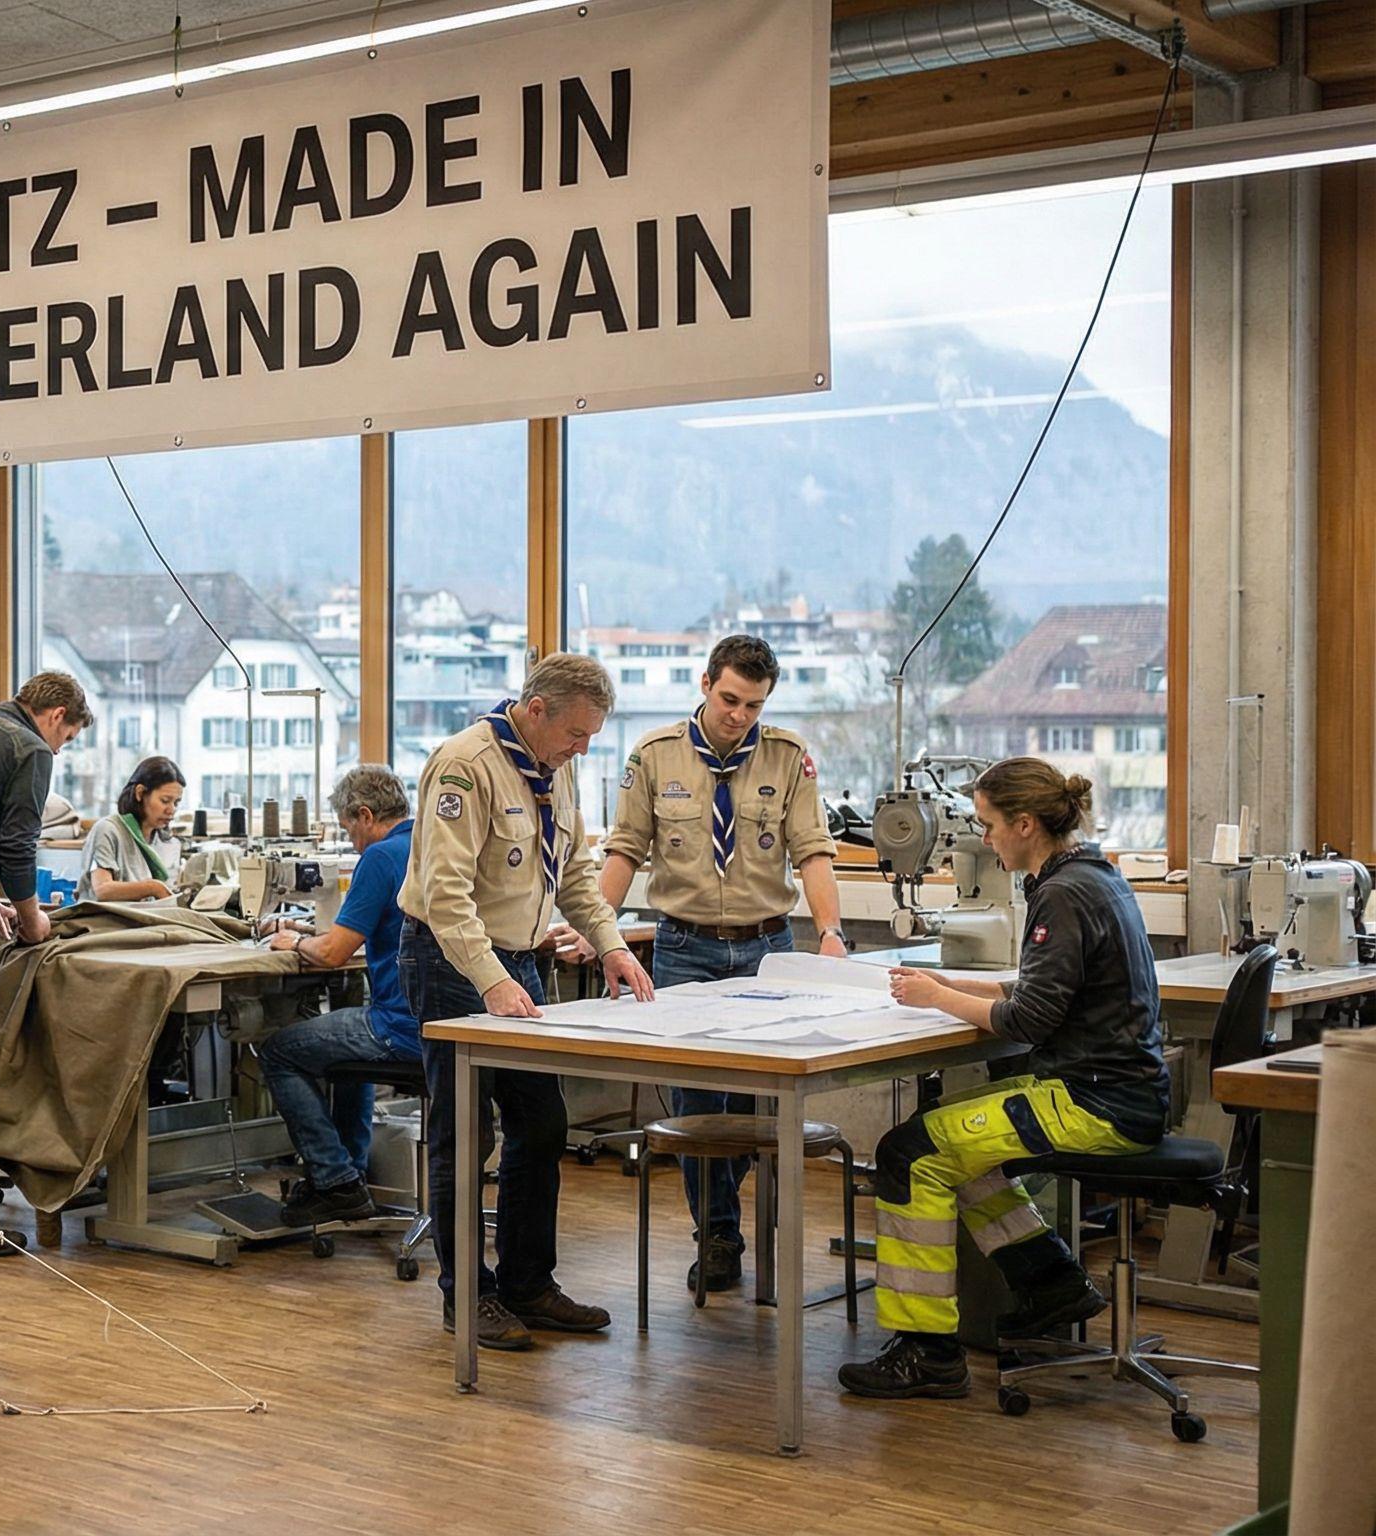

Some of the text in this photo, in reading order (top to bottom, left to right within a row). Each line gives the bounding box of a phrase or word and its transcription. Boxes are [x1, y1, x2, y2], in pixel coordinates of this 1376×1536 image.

[189, 94, 482, 244] MADE
[521, 67, 632, 193] IN
[391, 205, 753, 359] AGAIN
